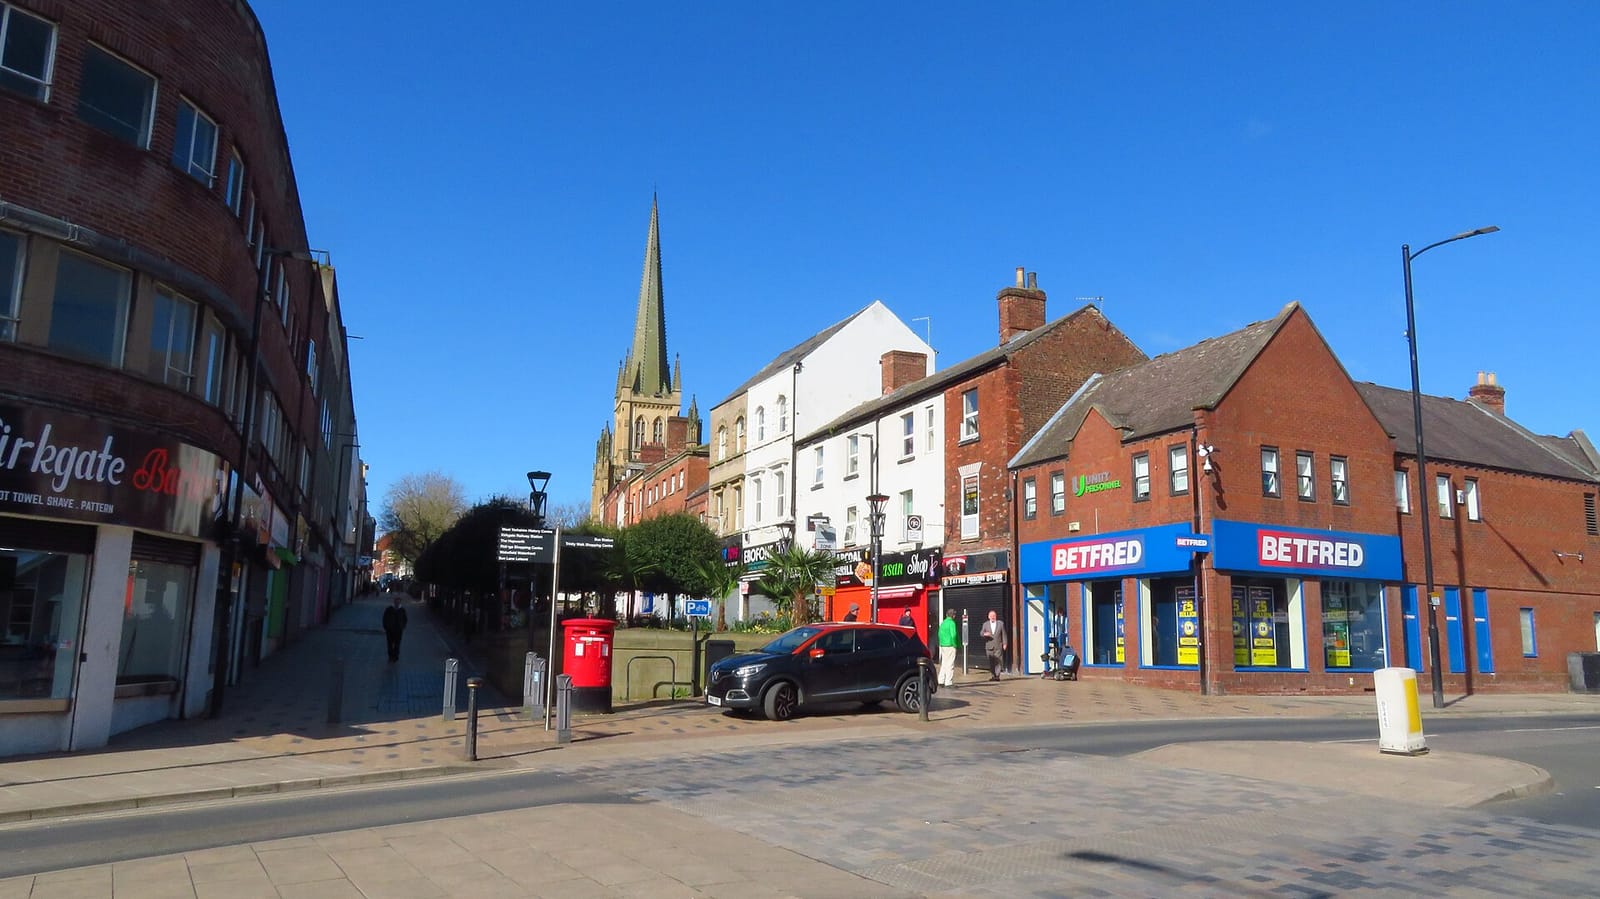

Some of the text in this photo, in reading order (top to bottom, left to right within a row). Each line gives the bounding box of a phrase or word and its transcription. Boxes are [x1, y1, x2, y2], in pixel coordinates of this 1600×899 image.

[0, 418, 125, 493] irkgate
[1085, 480, 1121, 493] PERSONNEL
[1086, 471, 1110, 485] UNITY
[13, 491, 43, 505] TOWEL
[47, 496, 74, 509] SHAVE
[80, 500, 114, 513] PATTERN
[1176, 538, 1208, 547] BETFRED
[1262, 535, 1363, 567] BETFRED
[907, 553, 928, 579] Shop
[1054, 540, 1142, 571] BETFRED
[687, 602, 695, 613] P
